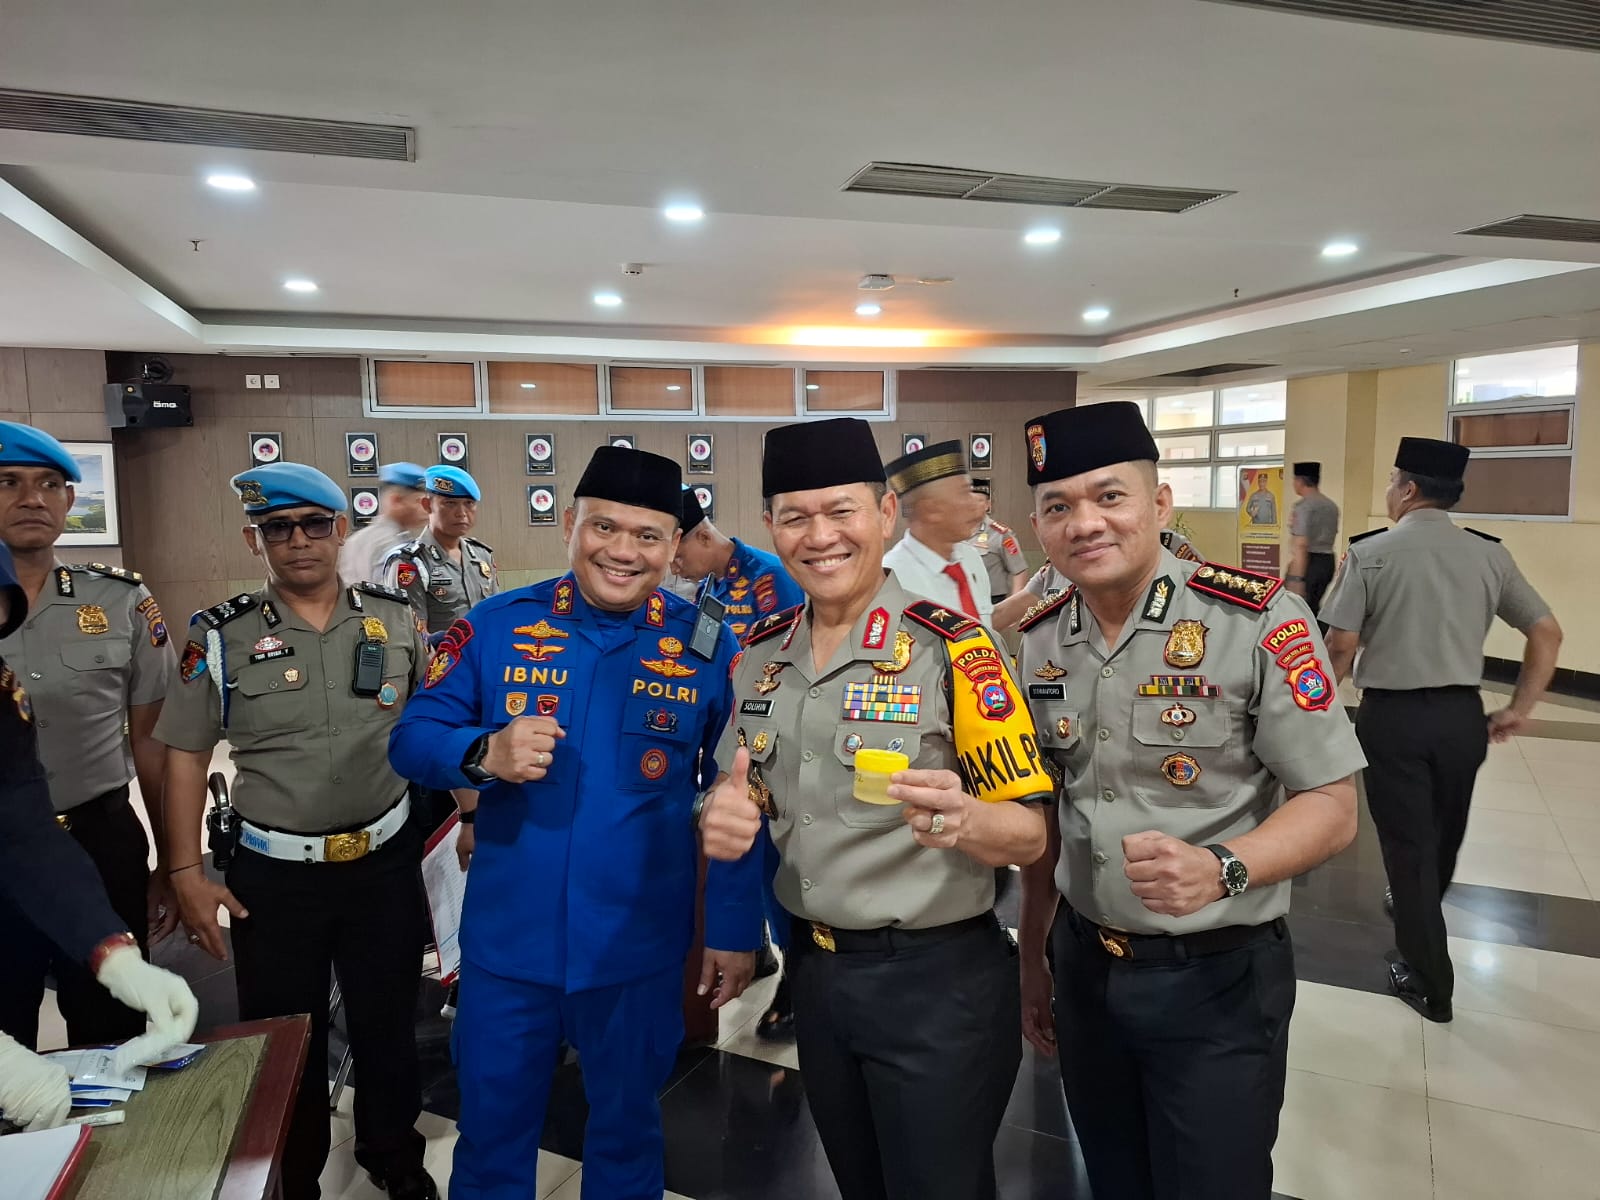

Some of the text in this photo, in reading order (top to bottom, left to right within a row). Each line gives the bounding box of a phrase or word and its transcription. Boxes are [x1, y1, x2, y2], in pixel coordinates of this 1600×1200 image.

[1270, 622, 1305, 648] POLDA
[957, 649, 997, 667] POLDA
[504, 665, 568, 685] IBNU
[632, 679, 697, 704] POLRI
